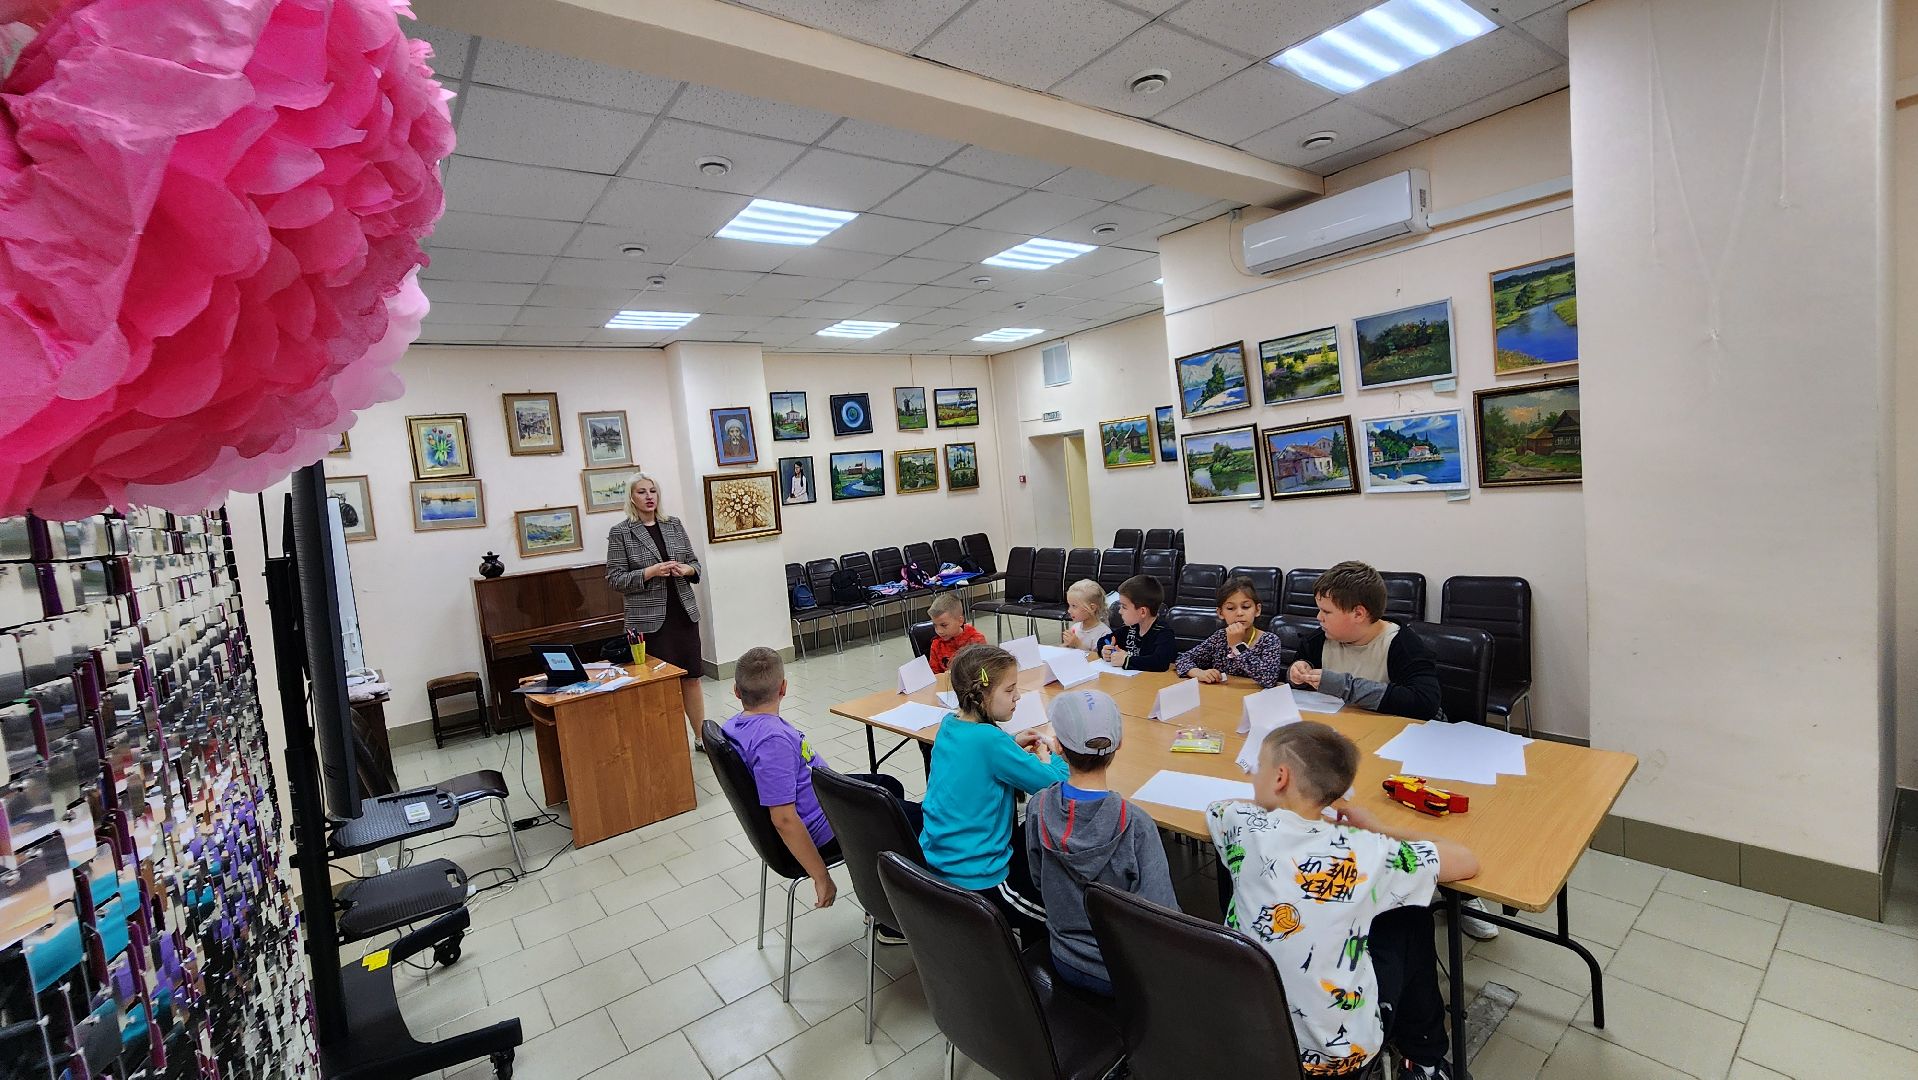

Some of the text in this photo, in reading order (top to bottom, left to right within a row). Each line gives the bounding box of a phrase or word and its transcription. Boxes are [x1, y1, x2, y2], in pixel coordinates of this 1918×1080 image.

[1298, 858, 1358, 884] GIVE UP
[1300, 878, 1356, 901] NEVER
